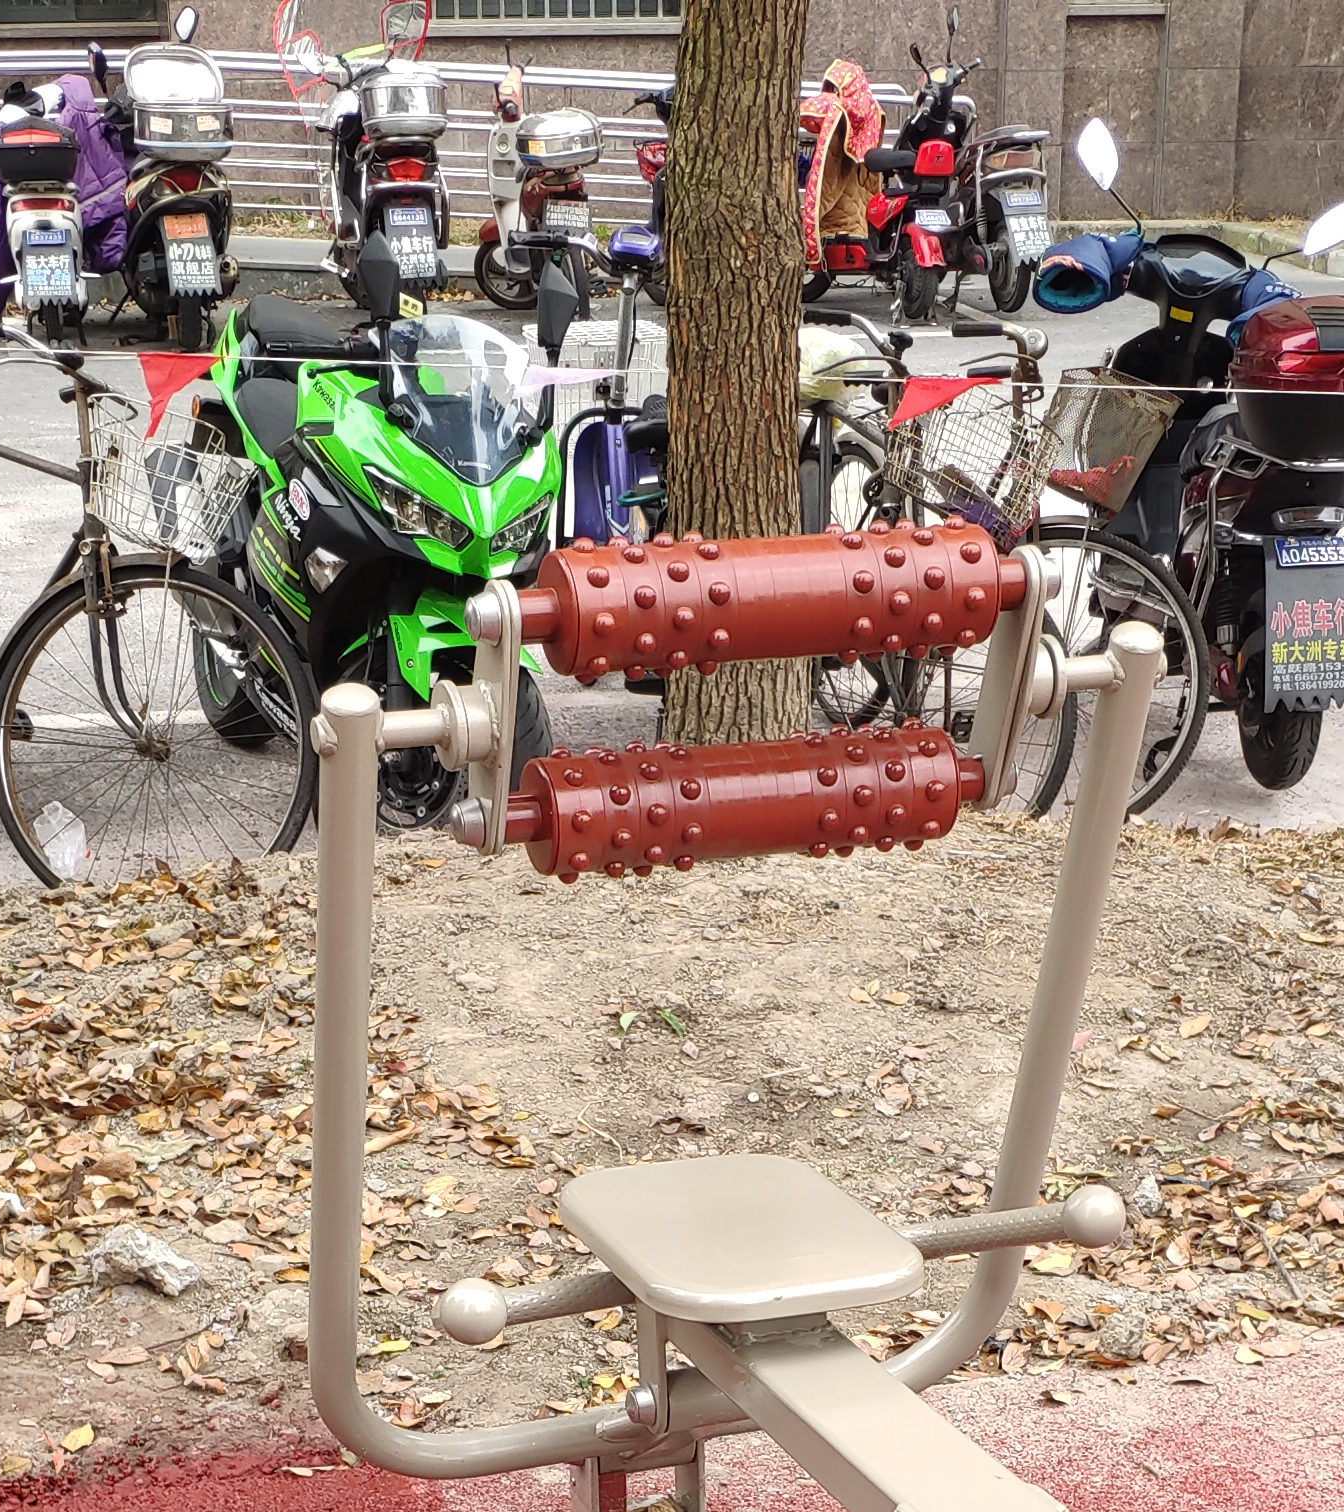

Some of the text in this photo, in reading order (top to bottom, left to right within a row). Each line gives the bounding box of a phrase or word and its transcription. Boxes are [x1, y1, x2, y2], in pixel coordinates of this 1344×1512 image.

[26, 254, 70, 269] 远大车行
[171, 261, 214, 275] 旗舰店
[275, 493, 301, 541] Ninja
